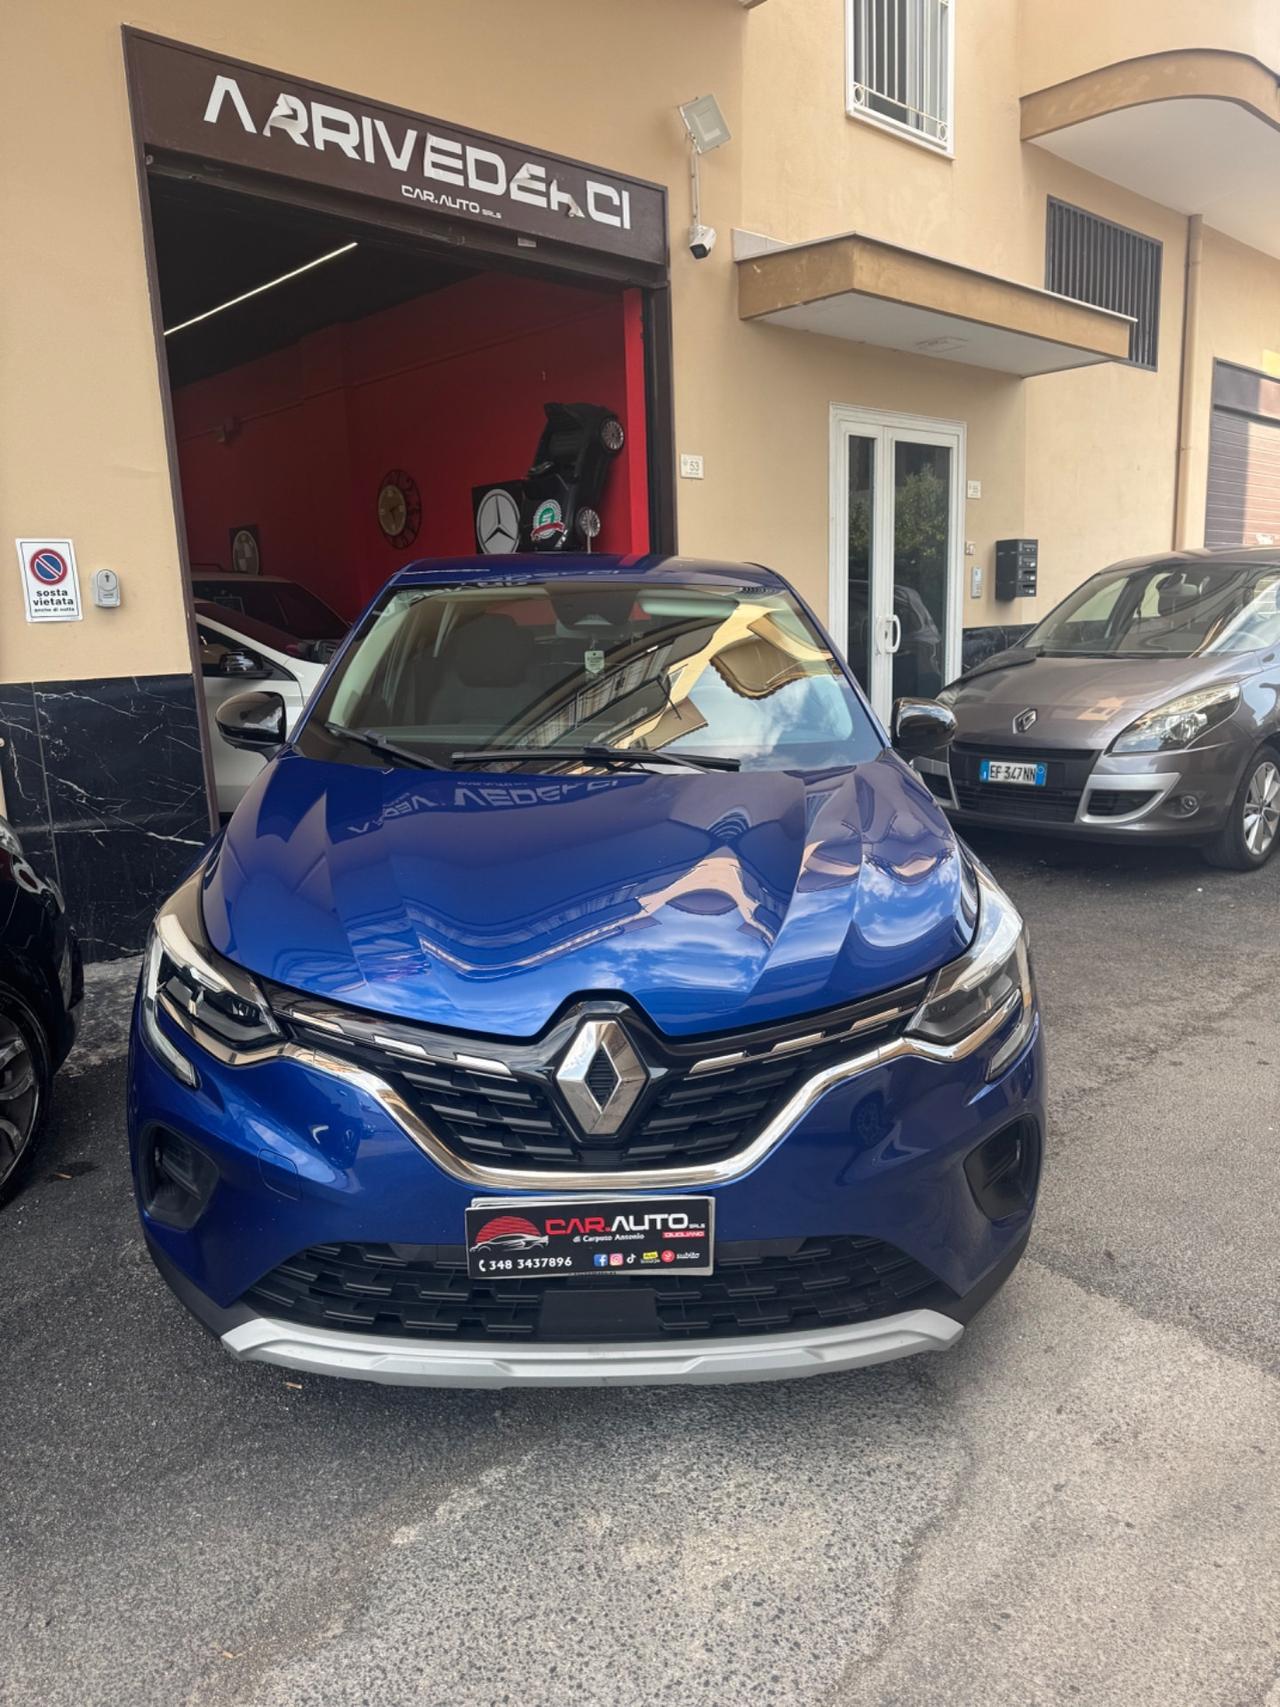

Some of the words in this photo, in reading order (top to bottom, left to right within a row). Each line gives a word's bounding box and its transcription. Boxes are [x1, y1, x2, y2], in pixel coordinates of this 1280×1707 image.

[401, 184, 480, 213] CAR.AUTO
[36, 588, 68, 597] sosta
[33, 598, 74, 606] vietata
[545, 1213, 688, 1235] CAR.AUTO
[614, 1233, 645, 1241] Antonio
[489, 1260, 513, 1271] 348
[517, 1256, 572, 1269] 3437896
